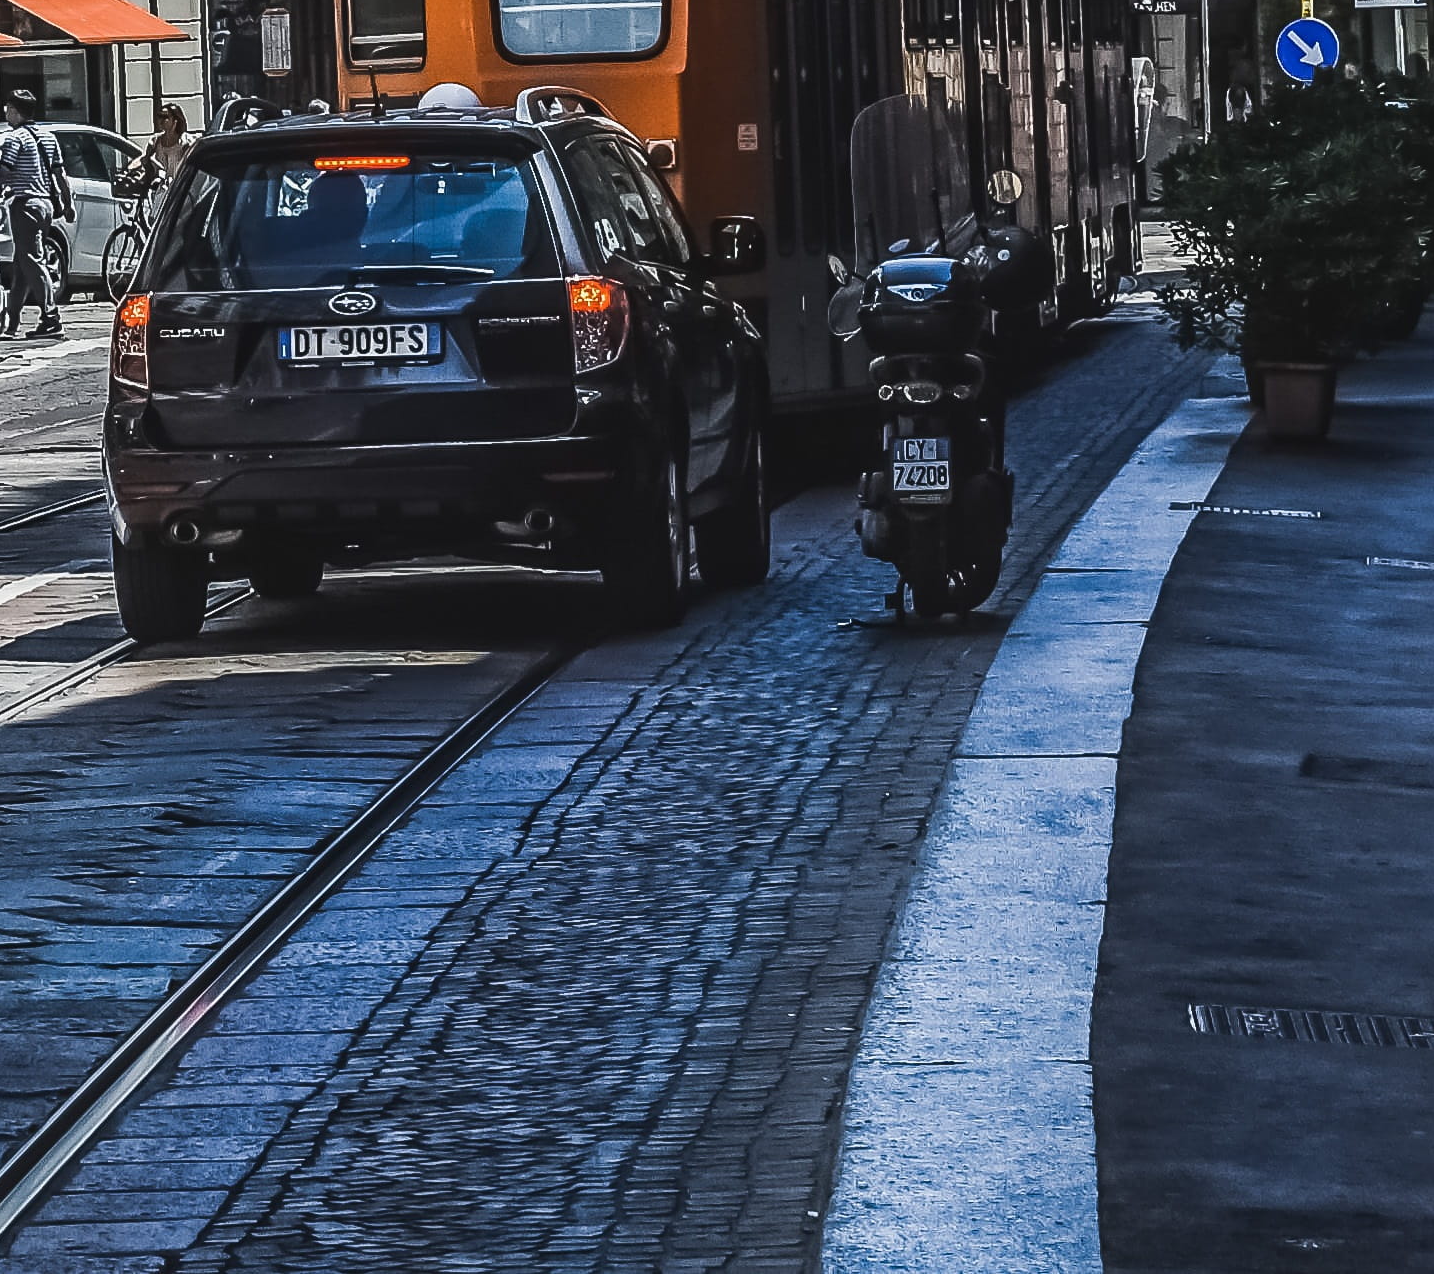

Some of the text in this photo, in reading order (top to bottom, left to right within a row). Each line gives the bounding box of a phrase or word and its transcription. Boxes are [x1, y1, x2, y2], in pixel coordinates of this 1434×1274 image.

[159, 328, 225, 338] SUBARU
[294, 327, 326, 357] DT
[339, 323, 425, 356] 909FS
[905, 440, 927, 460] CY
[894, 465, 948, 488] 74208
